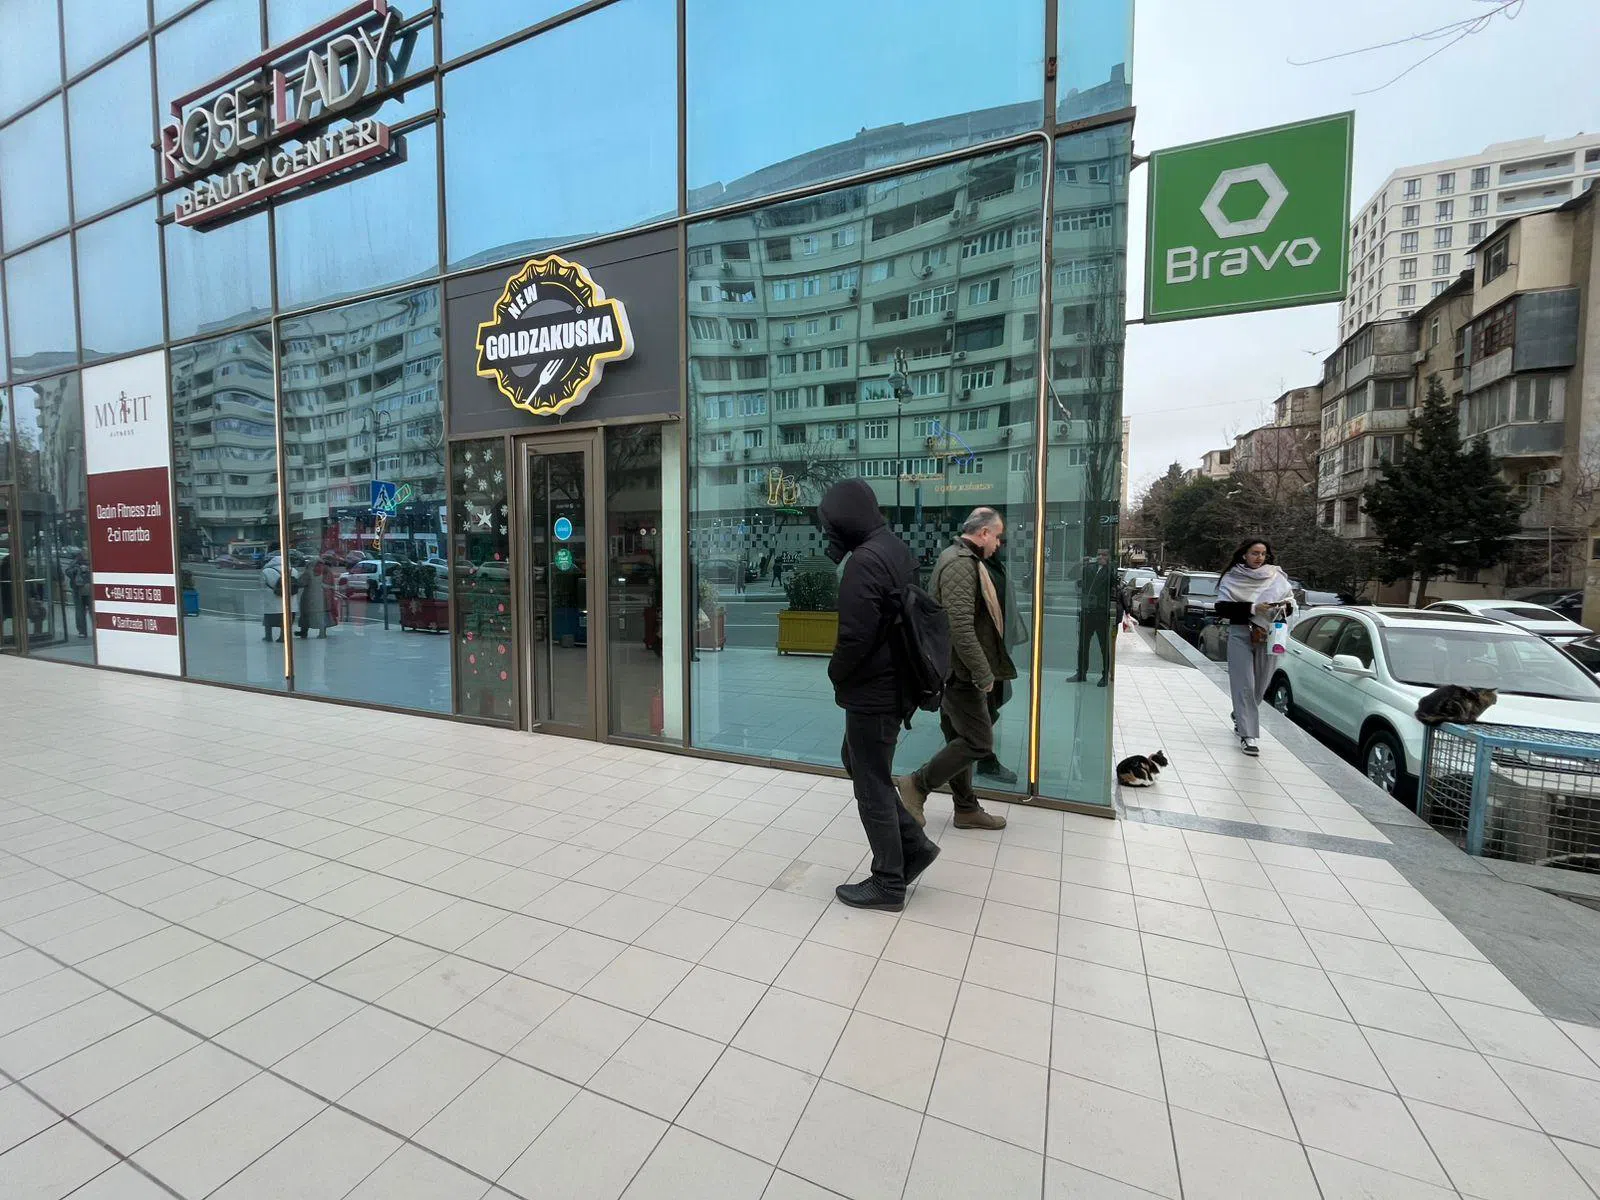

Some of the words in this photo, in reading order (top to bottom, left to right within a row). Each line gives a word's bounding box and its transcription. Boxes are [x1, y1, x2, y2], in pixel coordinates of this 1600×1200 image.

[160, 80, 264, 181] ROSE
[272, 11, 393, 134] LADY
[181, 157, 266, 215] BEAUTY
[272, 118, 377, 178] CENTER
[1166, 236, 1321, 285] Bravo
[507, 283, 538, 320] NEW
[485, 315, 615, 361] GOLDZAKUSKA
